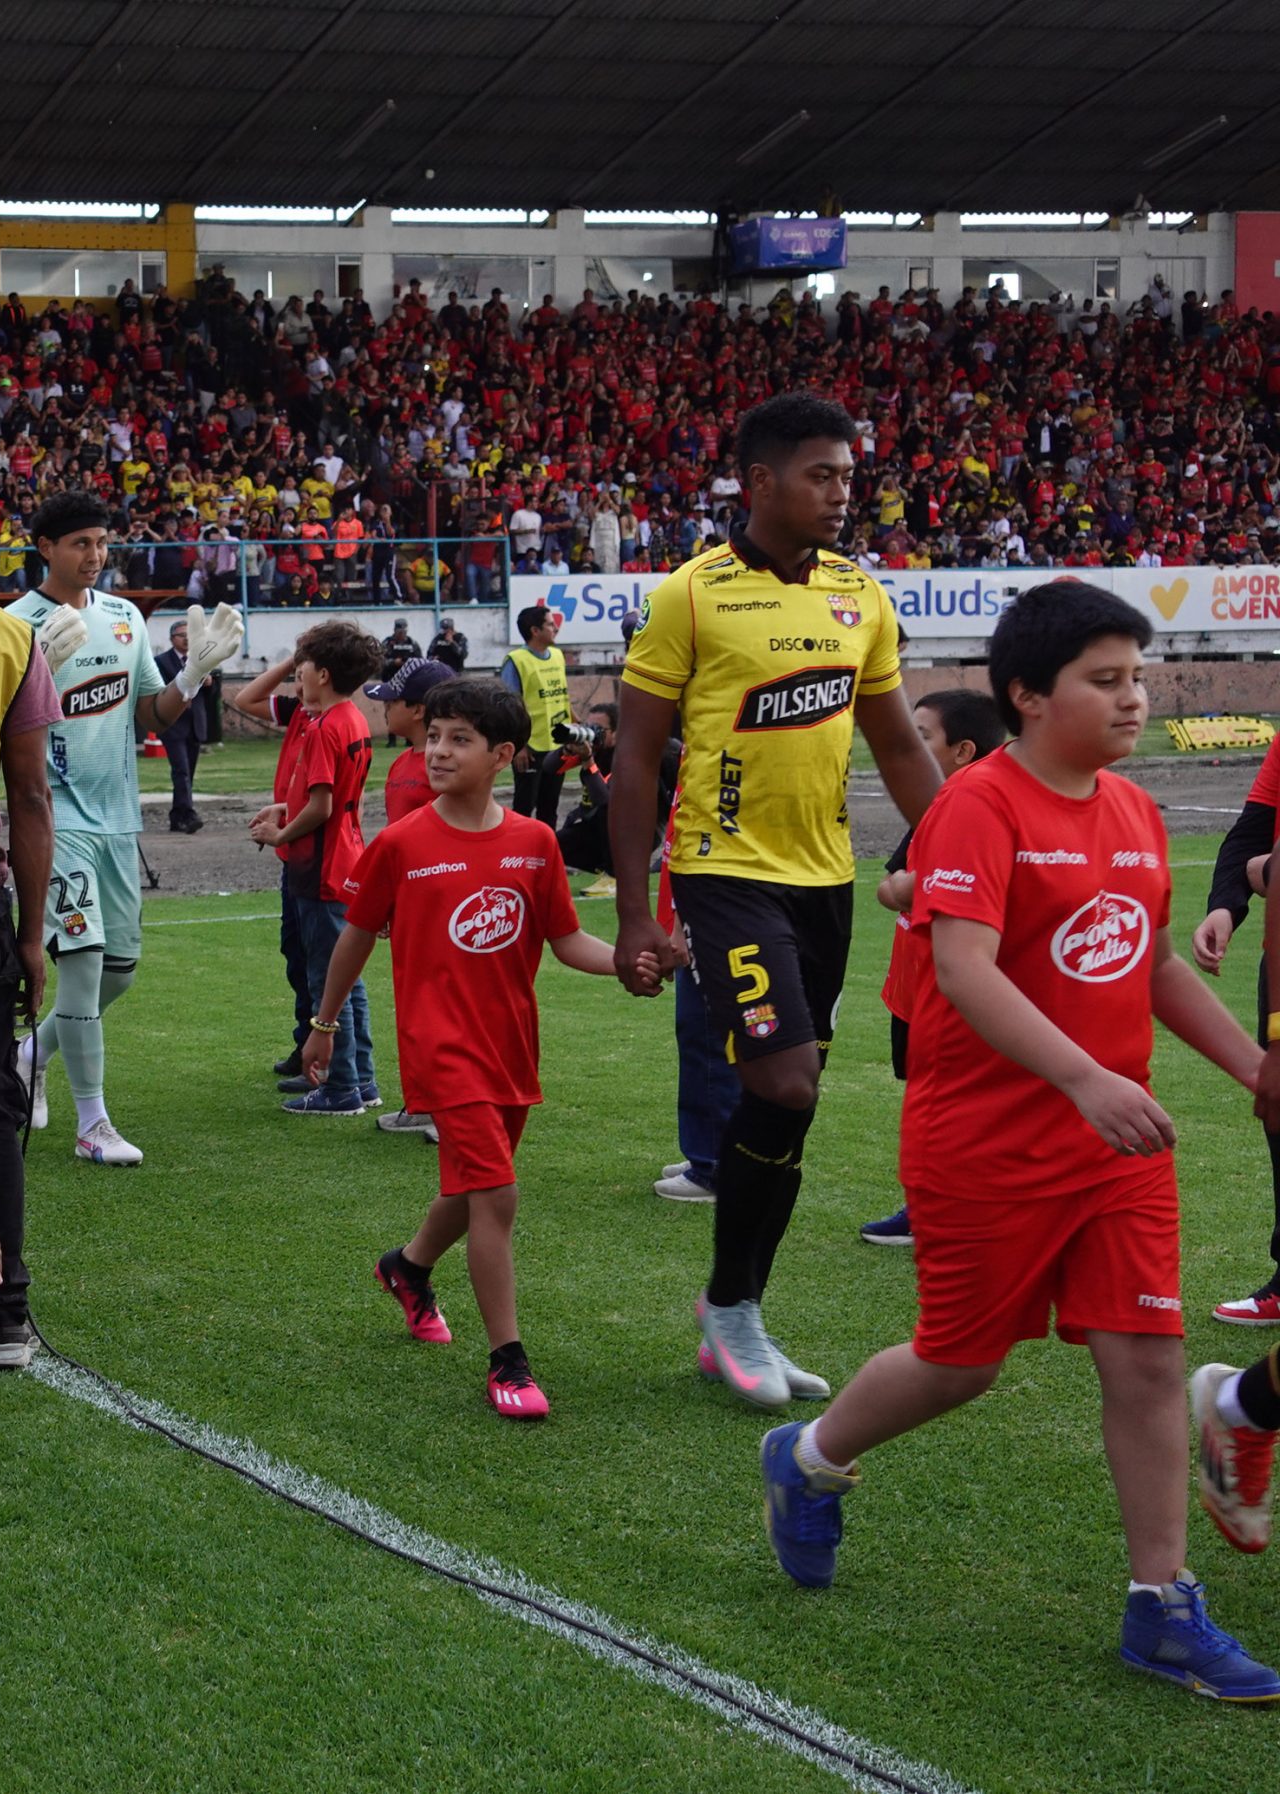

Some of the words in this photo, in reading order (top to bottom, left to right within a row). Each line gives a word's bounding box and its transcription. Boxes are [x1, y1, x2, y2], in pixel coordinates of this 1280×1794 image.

[581, 582, 640, 622] Sal
[717, 600, 781, 613] marathon
[879, 579, 1013, 617] aluds
[1211, 597, 1280, 620] CUEN
[75, 655, 119, 667] DISCOVER
[770, 638, 840, 652] DISCOVER
[70, 677, 127, 714] PILSENER
[755, 675, 851, 724] PILSENER
[407, 862, 468, 880] marathon
[1016, 850, 1088, 865] marathon
[49, 871, 93, 914] 22
[456, 895, 519, 938] PONY
[471, 920, 514, 949] Malta
[1062, 906, 1142, 957] PONY
[727, 943, 770, 1004] 5
[1077, 937, 1132, 975] Malta
